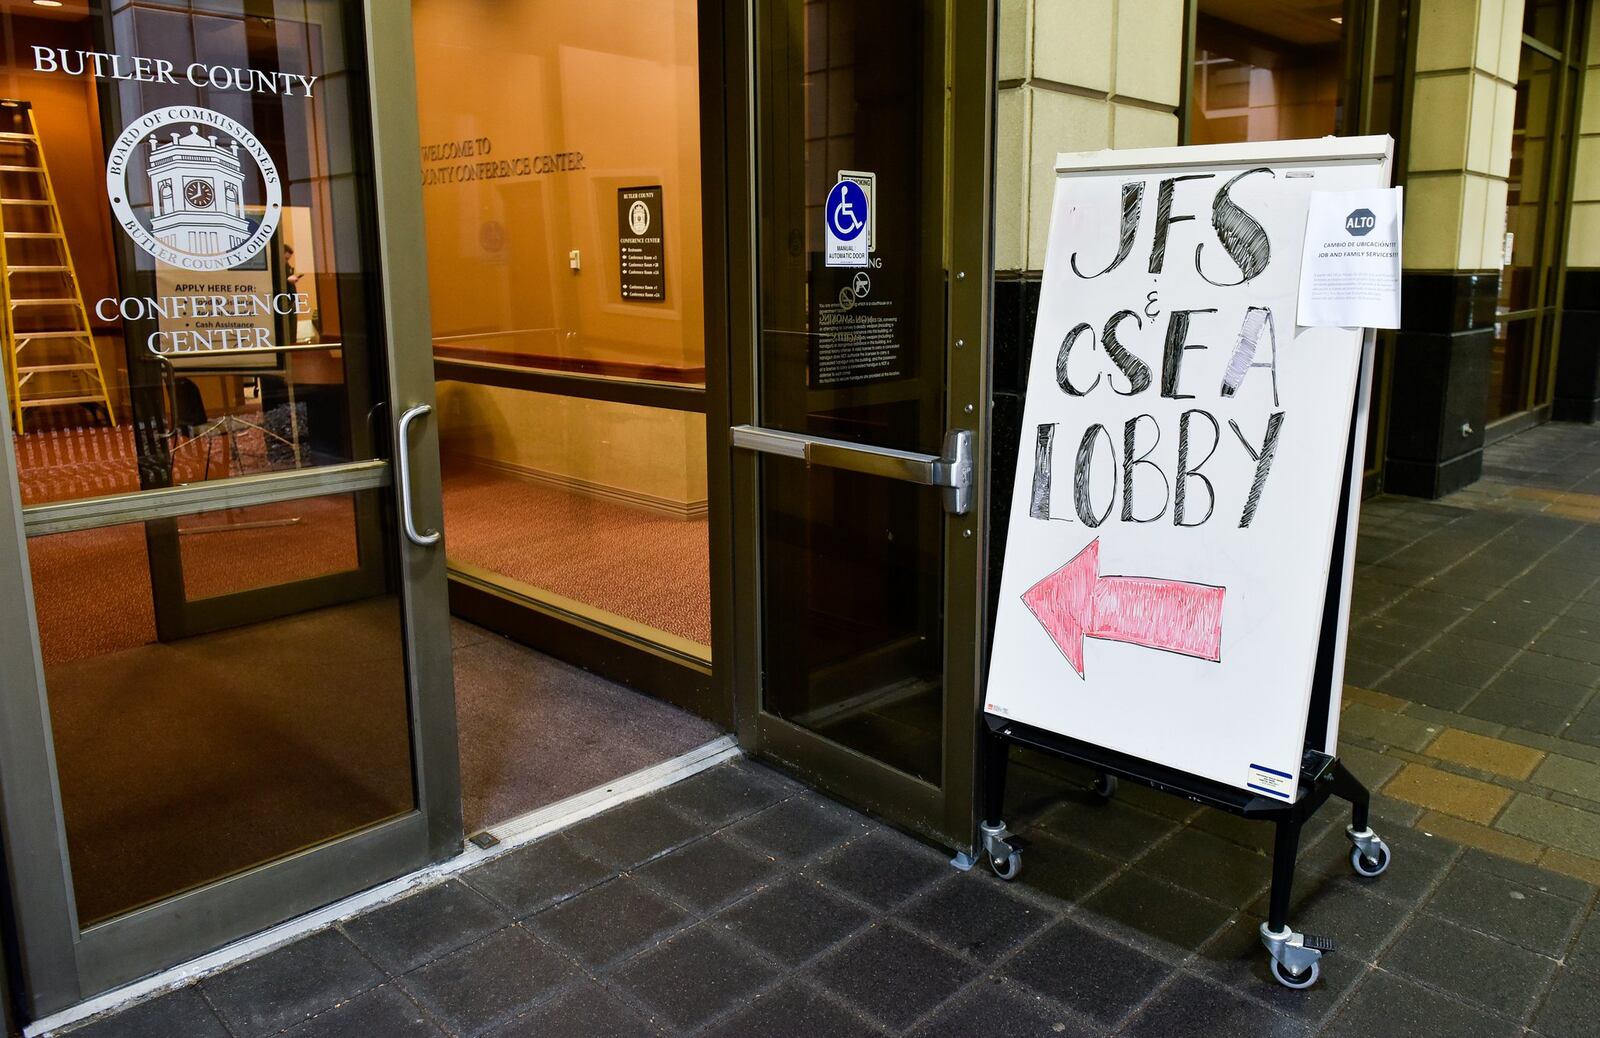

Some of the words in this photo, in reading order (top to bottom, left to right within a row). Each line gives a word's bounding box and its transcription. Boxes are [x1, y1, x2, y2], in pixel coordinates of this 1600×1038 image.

[30, 45, 180, 85] BUTLER
[186, 62, 319, 98] COUNTY
[110, 128, 140, 175] BOARD
[143, 112, 162, 128] OF
[168, 108, 277, 184] COMMISSIONERS
[422, 140, 474, 162] WELCOME
[475, 137, 491, 155] TO
[456, 158, 531, 182] CONFERENCE
[533, 151, 586, 175] CENTER
[1070, 167, 1276, 287] JFS
[1346, 216, 1374, 229] ALTO
[125, 218, 177, 264] BUTLER
[247, 224, 273, 254] OHIO
[175, 284, 205, 292] APPLY
[207, 284, 234, 292] HERE
[235, 285, 256, 293] FOR:
[95, 292, 312, 322] CONFERENCE
[195, 321, 213, 329] Cash
[147, 327, 274, 355] CENTER
[1056, 306, 1280, 407] CSEA
[1029, 409, 1286, 529] LOBBY
